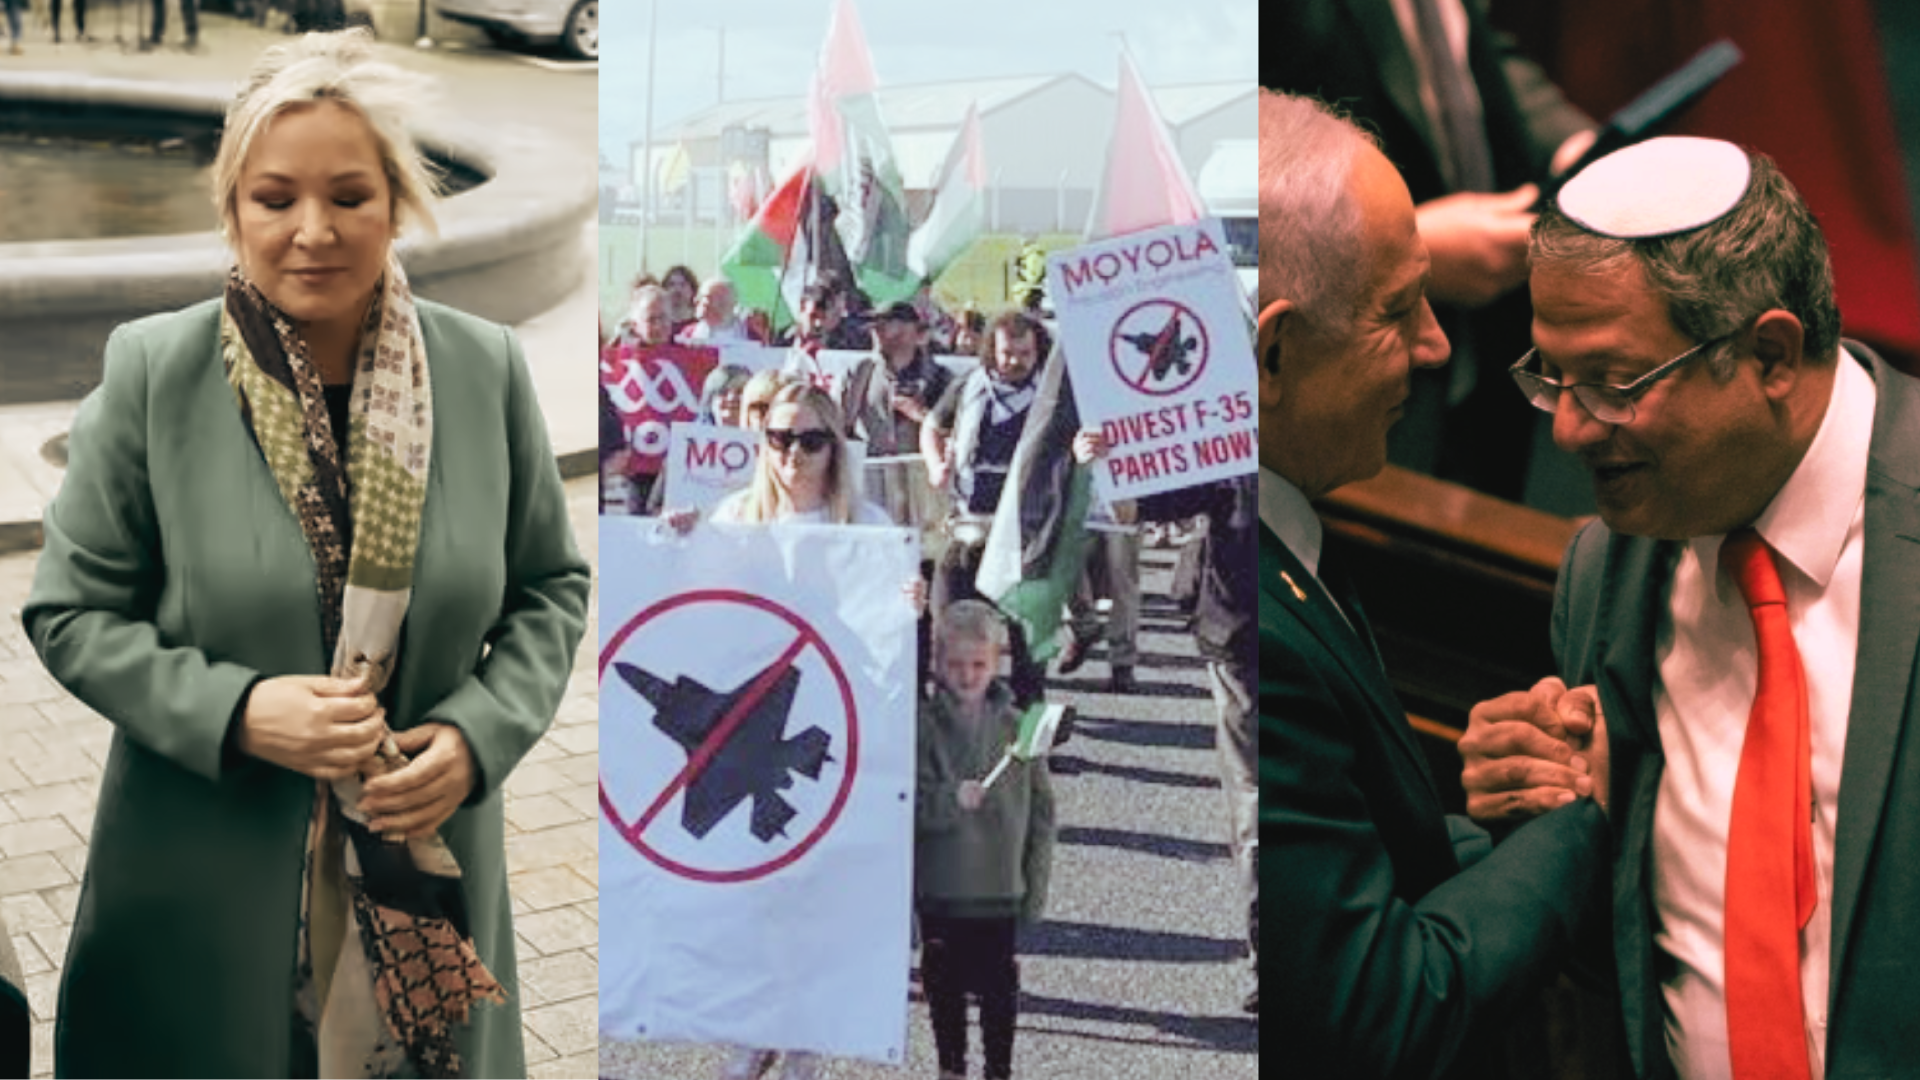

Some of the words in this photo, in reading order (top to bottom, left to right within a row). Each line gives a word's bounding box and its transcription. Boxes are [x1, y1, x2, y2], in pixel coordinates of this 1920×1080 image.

[1061, 229, 1219, 294] MOYOLA
[1102, 404, 1187, 448] DIVEST
[1193, 391, 1252, 429] F-35
[1109, 443, 1188, 488] PARTS
